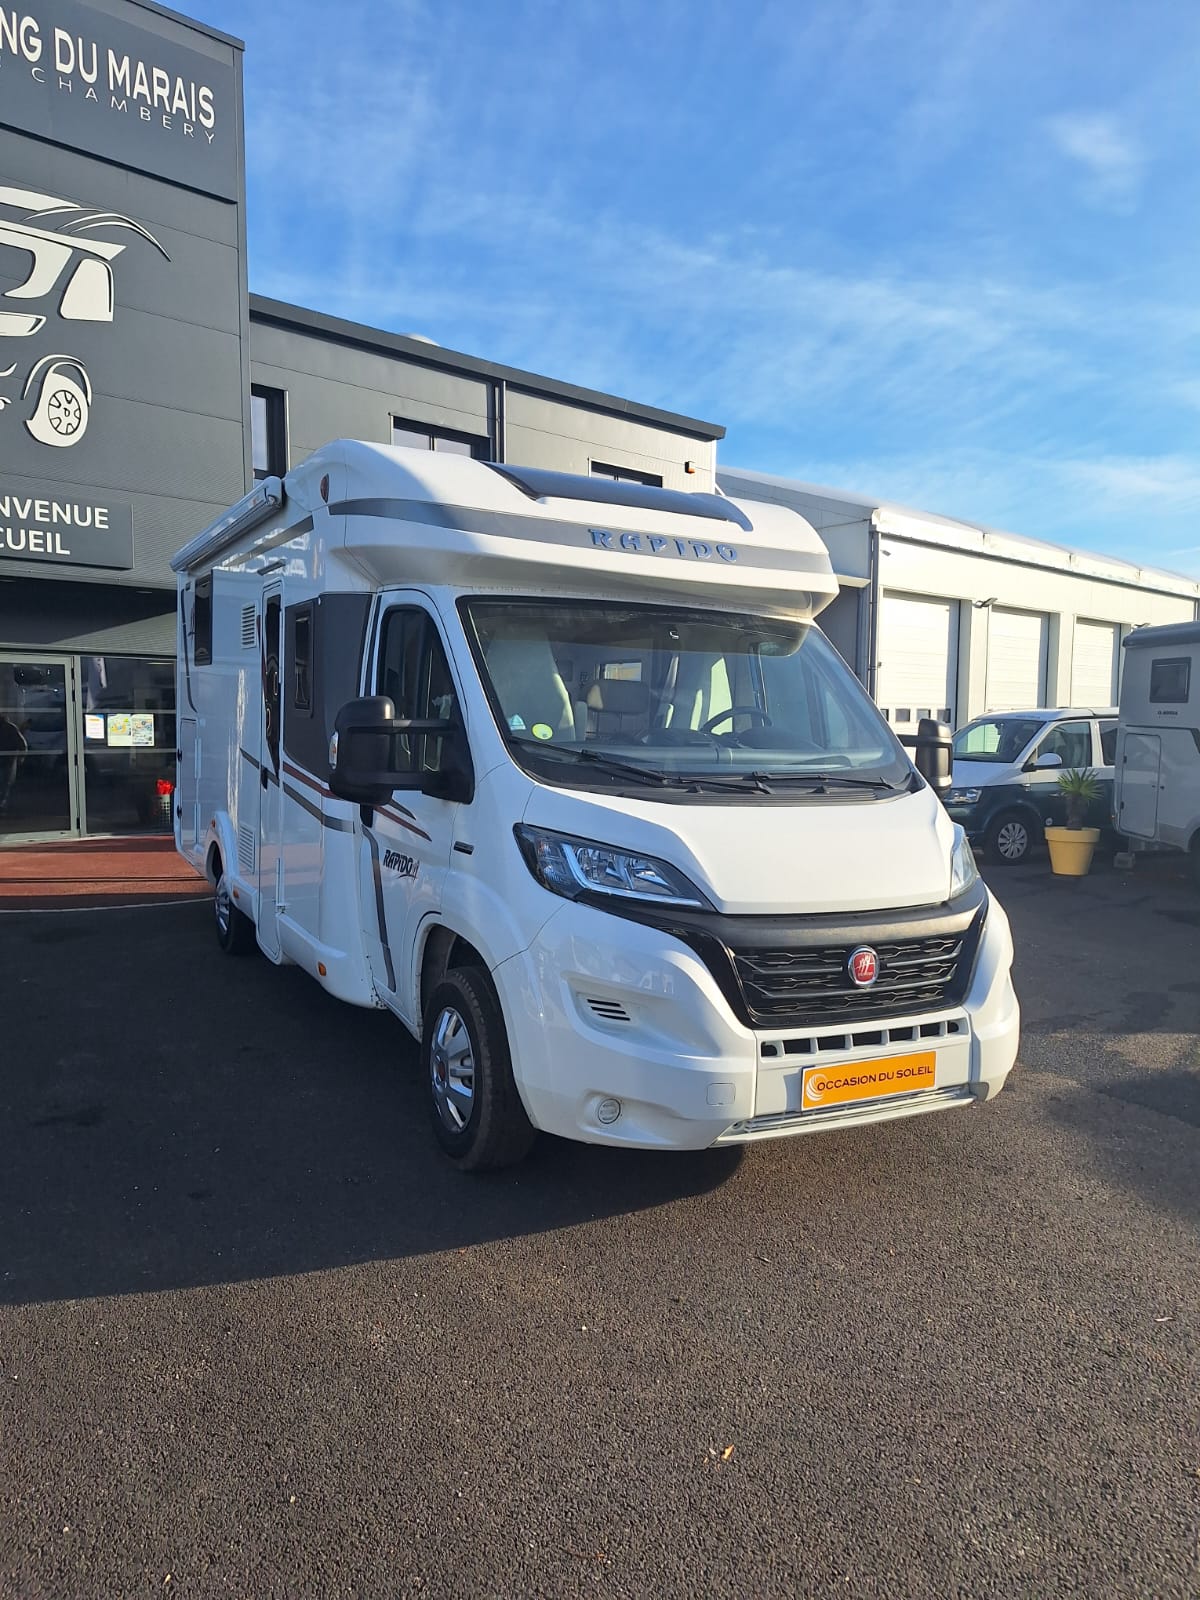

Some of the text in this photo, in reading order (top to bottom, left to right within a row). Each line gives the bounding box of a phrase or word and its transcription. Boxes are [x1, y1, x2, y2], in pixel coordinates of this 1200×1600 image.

[54, 27, 97, 84] DU
[107, 49, 215, 129] MARAIS
[31, 67, 215, 144] CHAMBERY
[0, 526, 71, 555] UEIL
[587, 528, 738, 563] RAPIDO
[383, 849, 414, 875] RAPIDO
[817, 1066, 933, 1091] OCCASION DU SOLEIL
